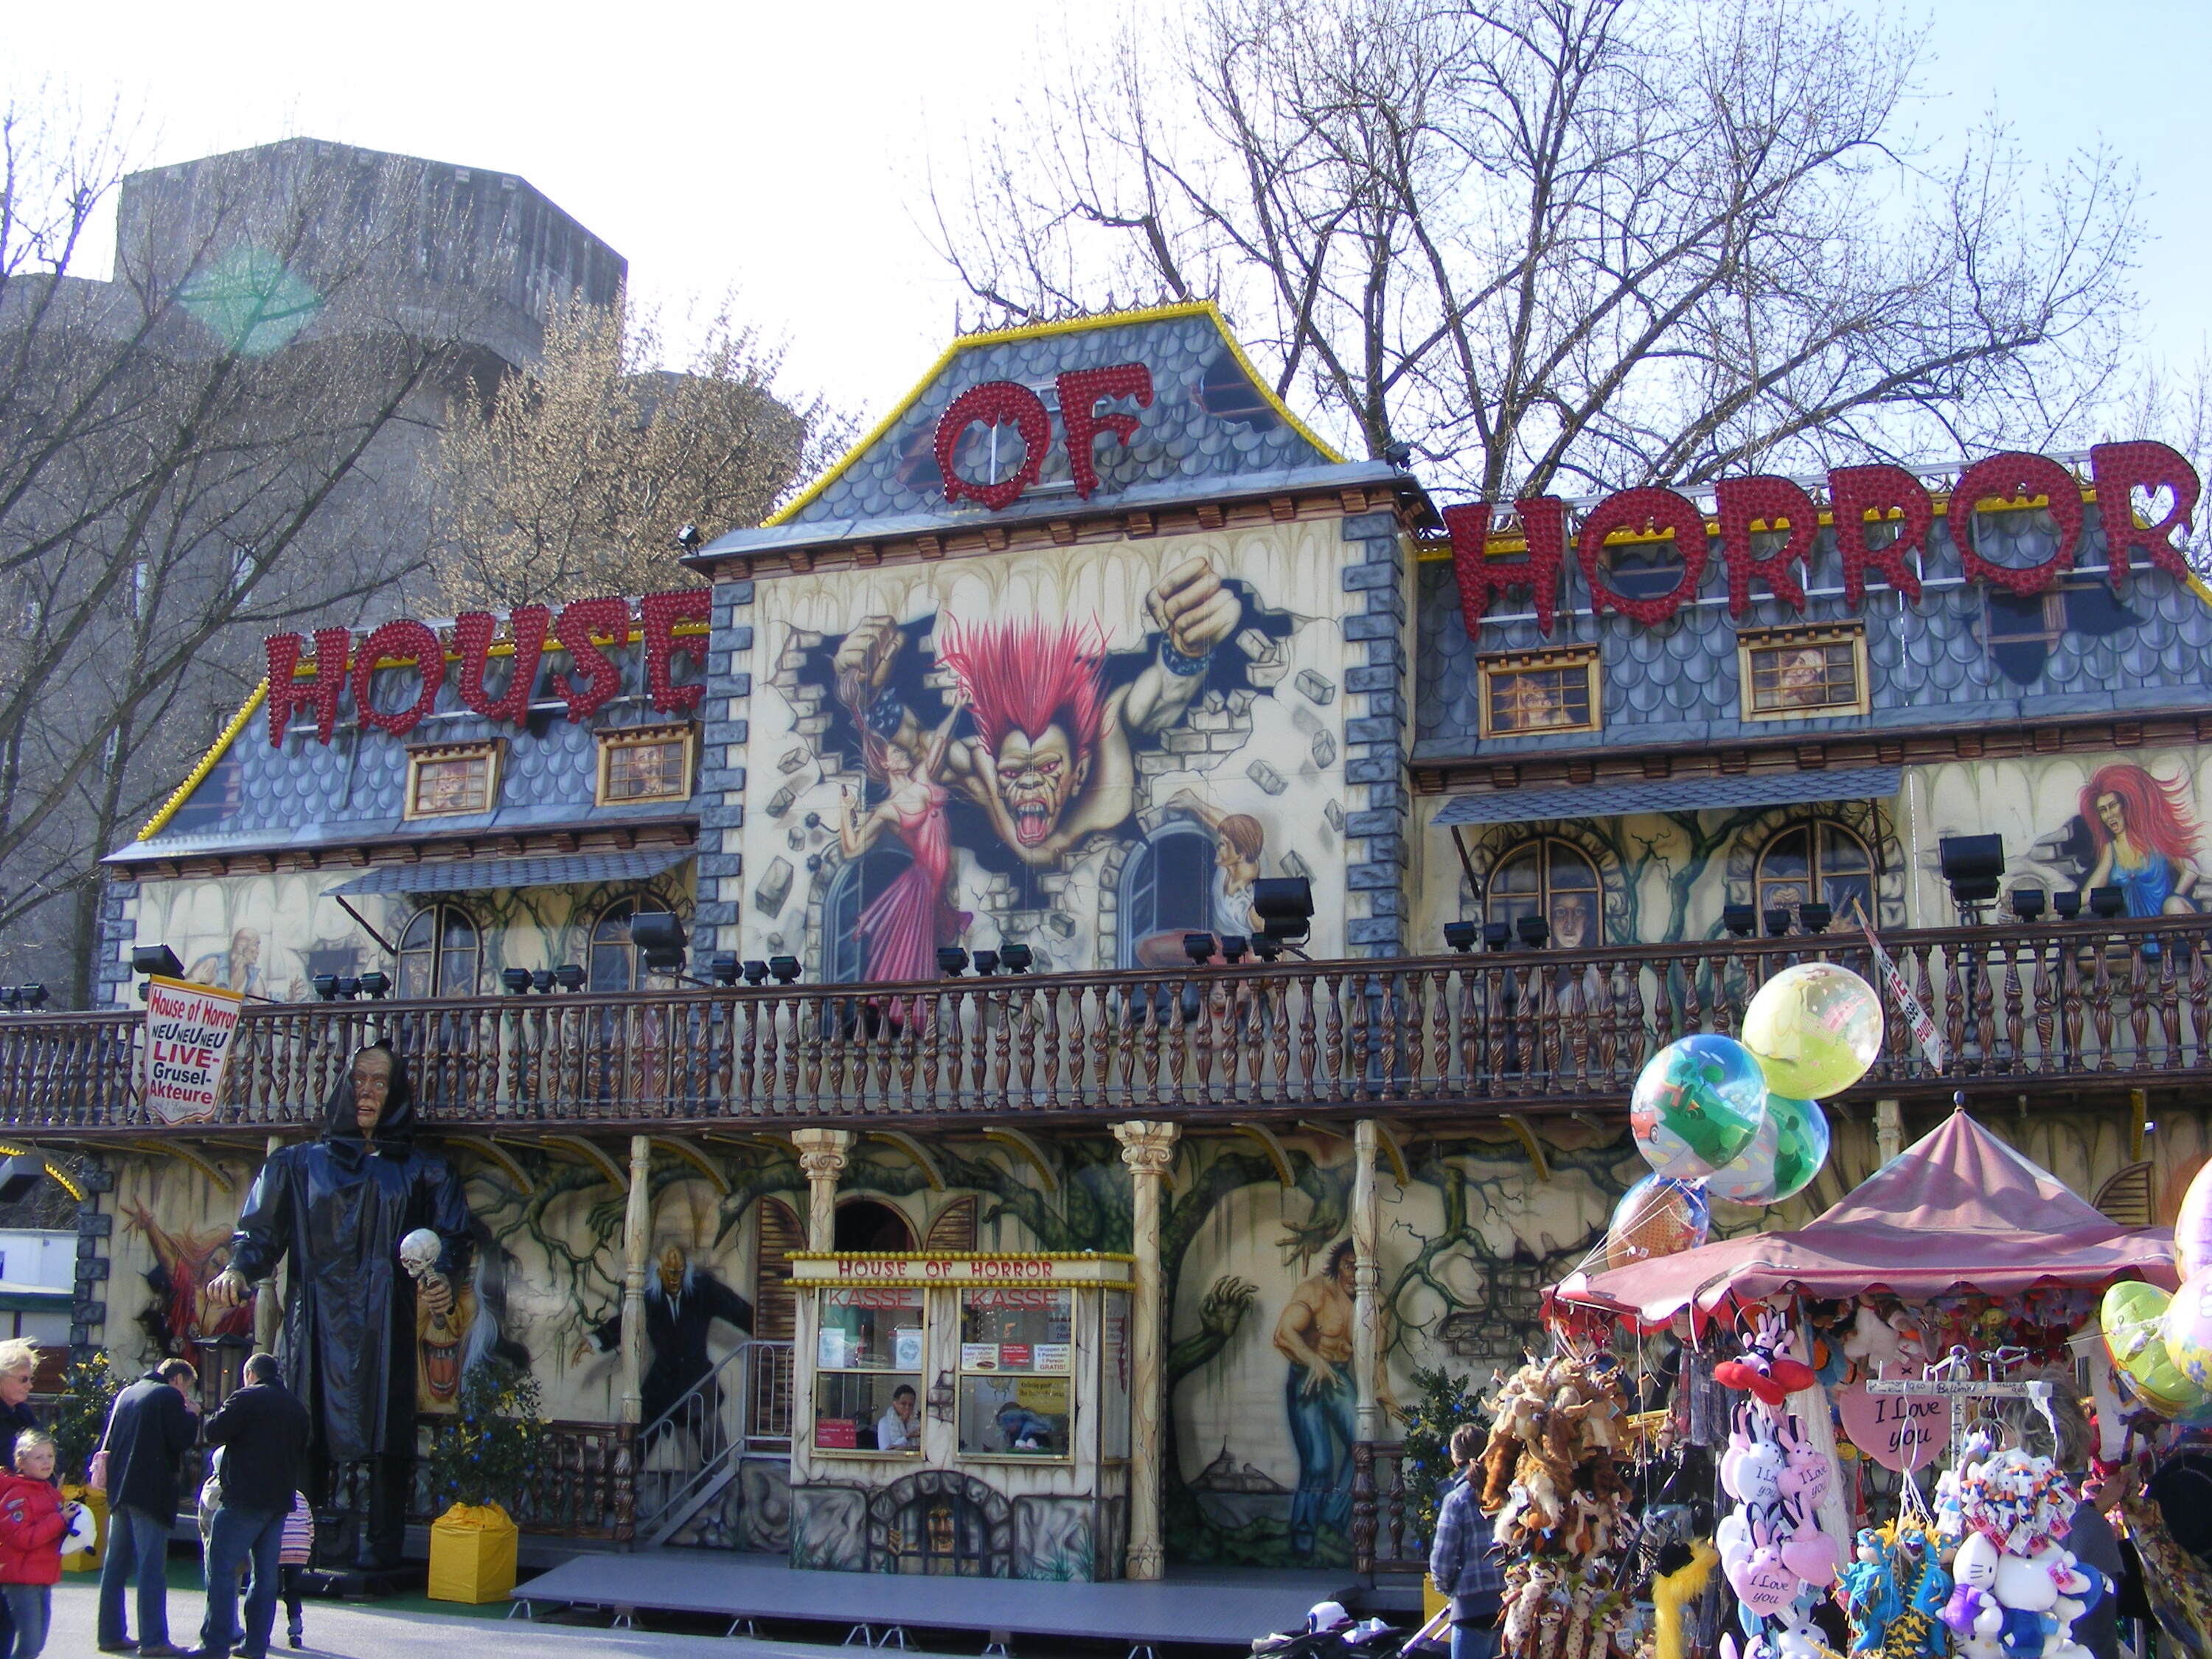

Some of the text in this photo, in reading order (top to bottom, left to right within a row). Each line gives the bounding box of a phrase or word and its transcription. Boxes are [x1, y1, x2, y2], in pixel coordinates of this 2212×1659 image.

[934, 362, 1154, 512] OF
[1442, 441, 2202, 643] HORROR
[265, 586, 713, 748] HOUSE
[150, 988, 237, 1030] House of Horror
[152, 1023, 229, 1048] NEU NEU NEU
[153, 1040, 220, 1069] LIVE-
[153, 1062, 212, 1085] Grusel-
[150, 1079, 213, 1105] Akteure
[838, 1259, 1054, 1278] HOUSE OF HORROR
[828, 1288, 913, 1310] KASSE
[970, 1289, 1060, 1312] KASSE
[1875, 1397, 1942, 1424] I Love
[1888, 1427, 1933, 1453] you
[1756, 1466, 1777, 1484] I Lo
[1799, 1466, 1829, 1485] I Love
[1756, 1486, 1776, 1498] you
[1811, 1480, 1827, 1499] you
[1750, 1575, 1790, 1591] I Love
[1751, 1591, 1779, 1604] you
